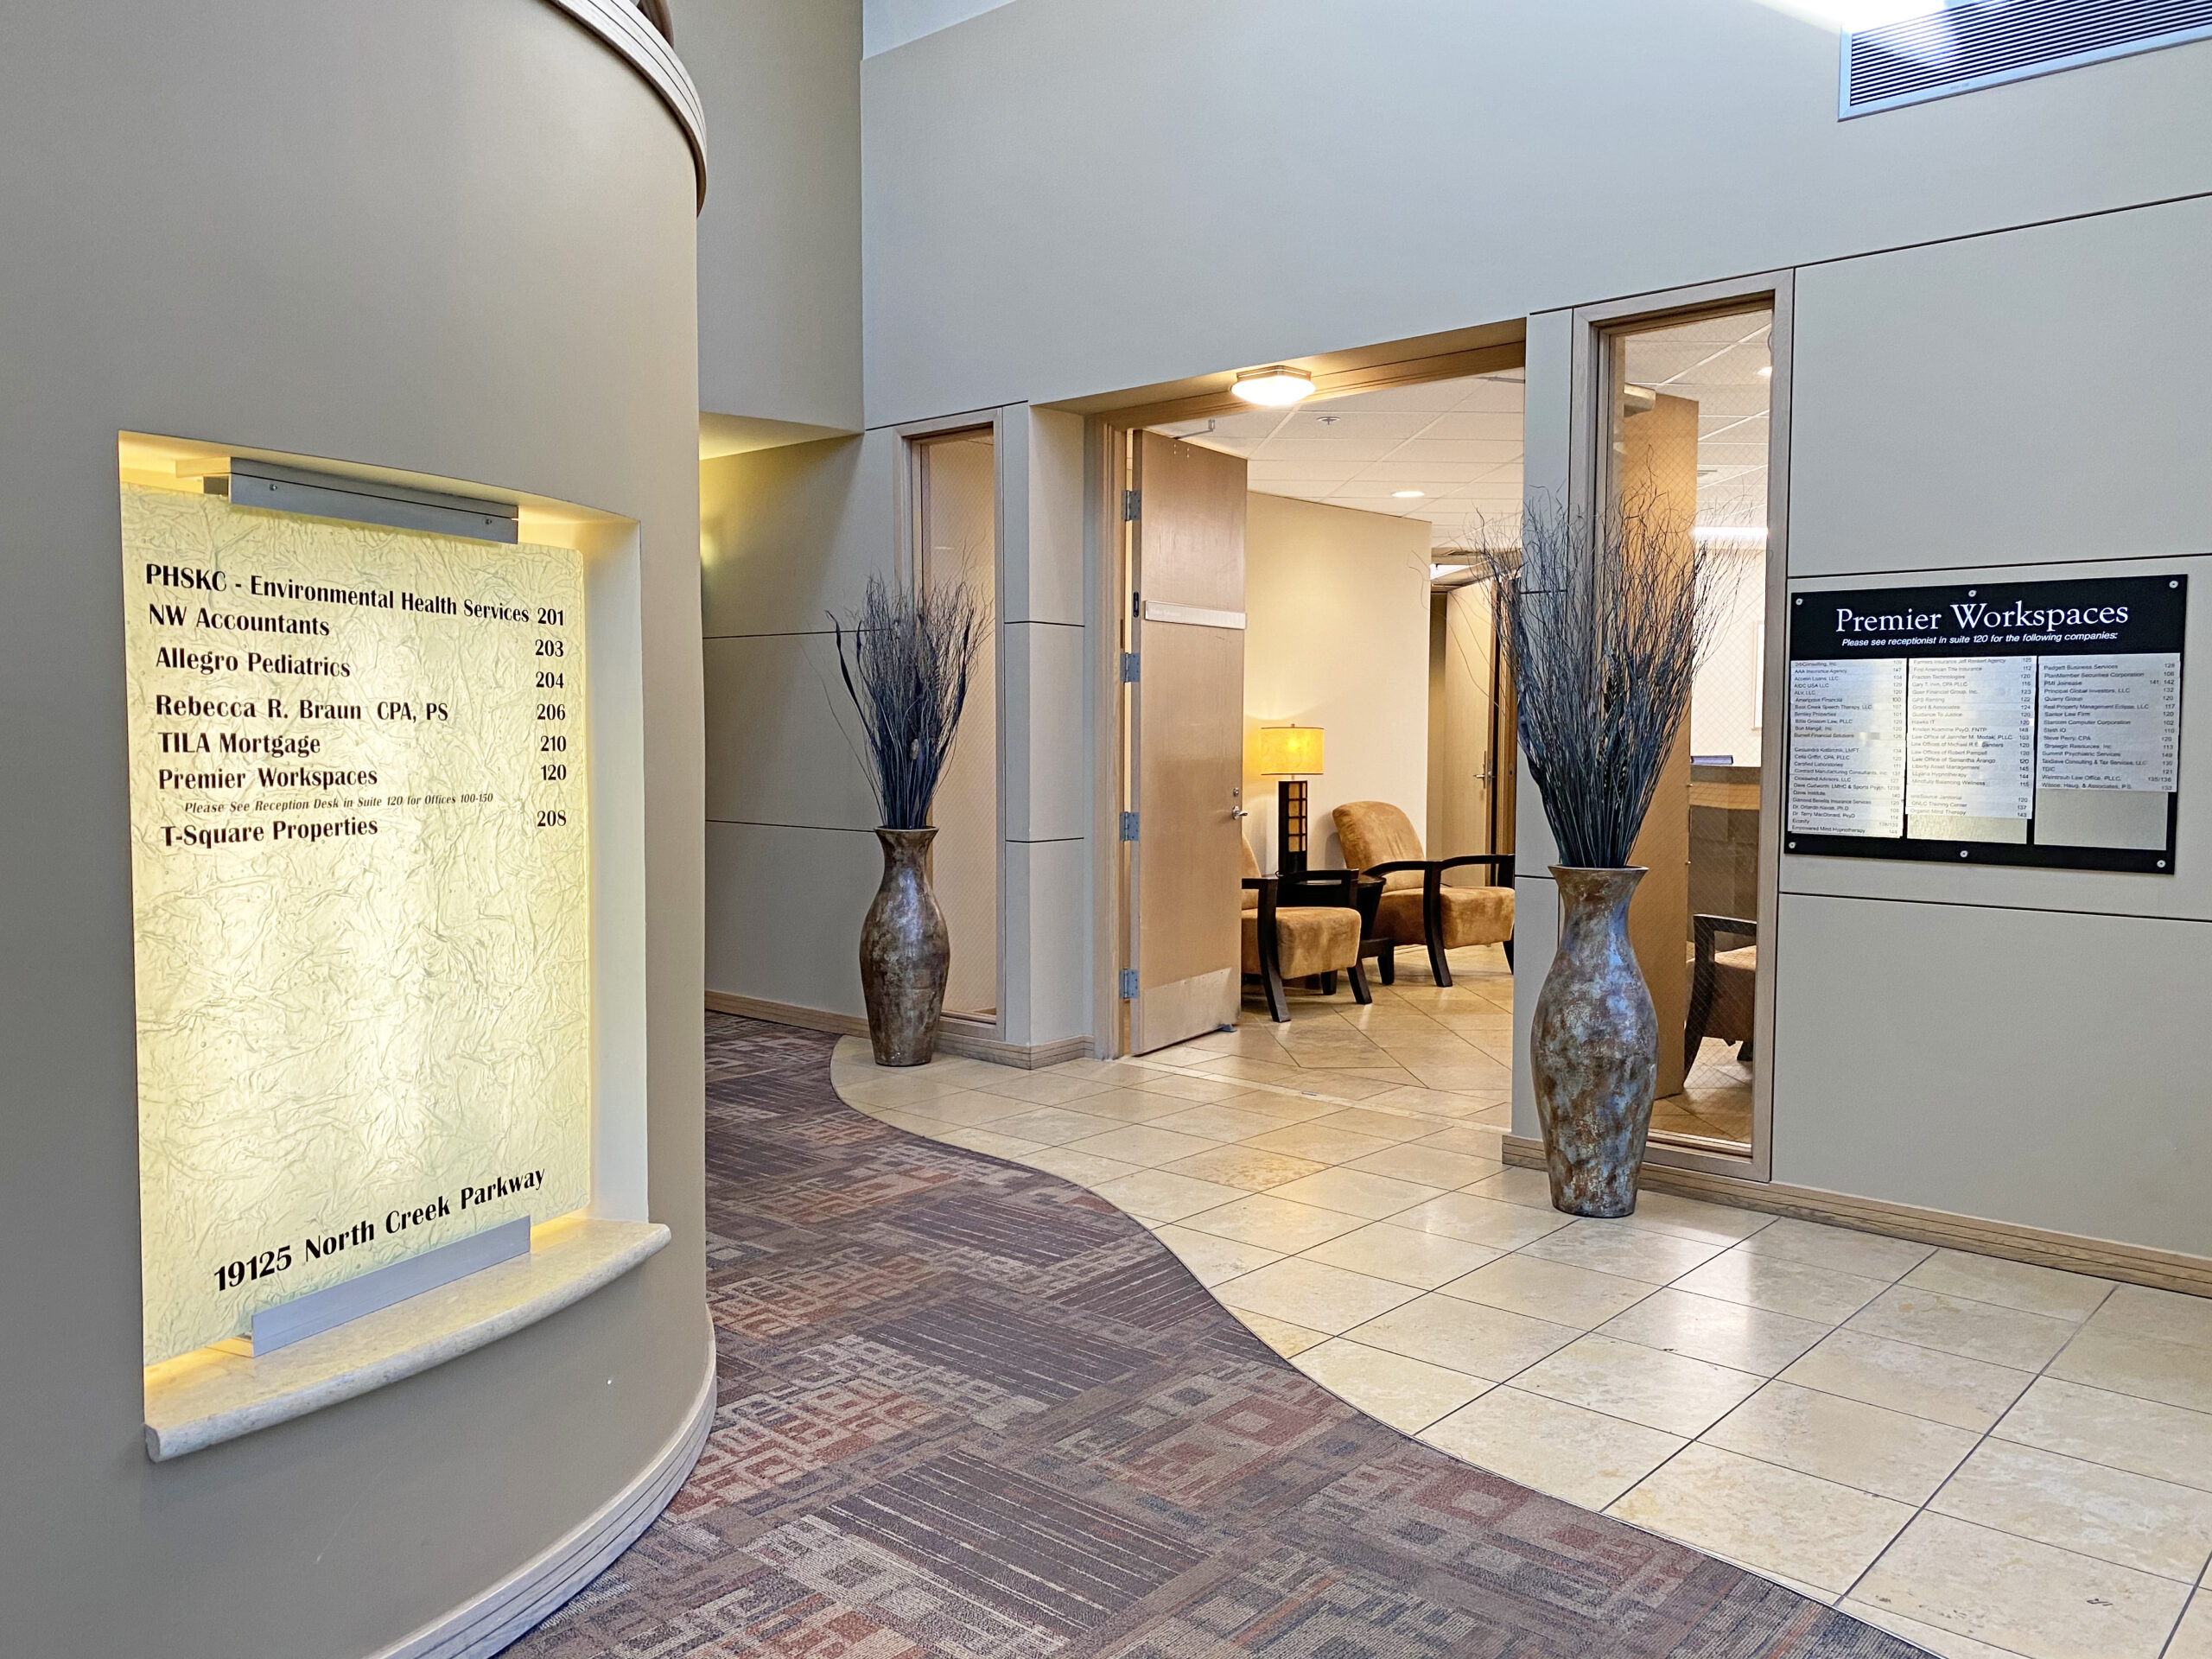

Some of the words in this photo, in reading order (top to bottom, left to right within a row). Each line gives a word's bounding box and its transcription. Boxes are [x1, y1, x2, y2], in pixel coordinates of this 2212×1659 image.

[146, 563, 227, 593] PHSKC
[251, 575, 394, 608] Environmental
[402, 592, 456, 615] Health
[463, 599, 529, 623] Services
[537, 608, 564, 626] 201
[149, 604, 187, 627] NW
[196, 607, 330, 637] Accountants
[535, 640, 564, 658] 203
[1836, 607, 1942, 633] Premier
[1950, 601, 2128, 632] Workspaces
[1842, 638, 1868, 647] Please
[1871, 638, 1885, 646] see
[1887, 635, 1936, 646] receptionist
[1949, 634, 1970, 645] suite
[1974, 634, 1988, 643] 120
[1991, 632, 2005, 643] for
[2006, 633, 2020, 642] the
[2023, 632, 2063, 644] following
[2064, 631, 2118, 643] companies:
[156, 647, 238, 674] Allegro
[248, 653, 351, 677] Pediatrics
[536, 671, 564, 690] 204
[156, 695, 256, 718] Rebecca
[268, 699, 289, 719] R.
[300, 700, 361, 720] Braun
[377, 702, 416, 722] CPA,
[426, 703, 448, 721] PS
[537, 704, 566, 721] 206
[158, 732, 211, 754] TILA
[219, 732, 321, 759] Mortgage
[540, 735, 567, 752] 210
[159, 769, 245, 790] Premier
[257, 767, 378, 788] Workspaces
[540, 765, 567, 781] 120
[185, 802, 224, 815] Please
[230, 801, 250, 812] See
[256, 799, 309, 811] Reception
[314, 798, 339, 810] Desk
[344, 798, 353, 808] in
[358, 797, 382, 808] Suite
[387, 796, 403, 806] 120
[407, 795, 421, 805] for
[424, 794, 456, 805] Offices
[461, 793, 493, 804] 100-150
[161, 822, 264, 849] T-Square
[273, 817, 378, 844] Properties
[537, 810, 567, 828] 208
[214, 1244, 292, 1291] 19125
[305, 1220, 374, 1262] North
[386, 1195, 450, 1234] Creek
[461, 1167, 545, 1210] Parkway
